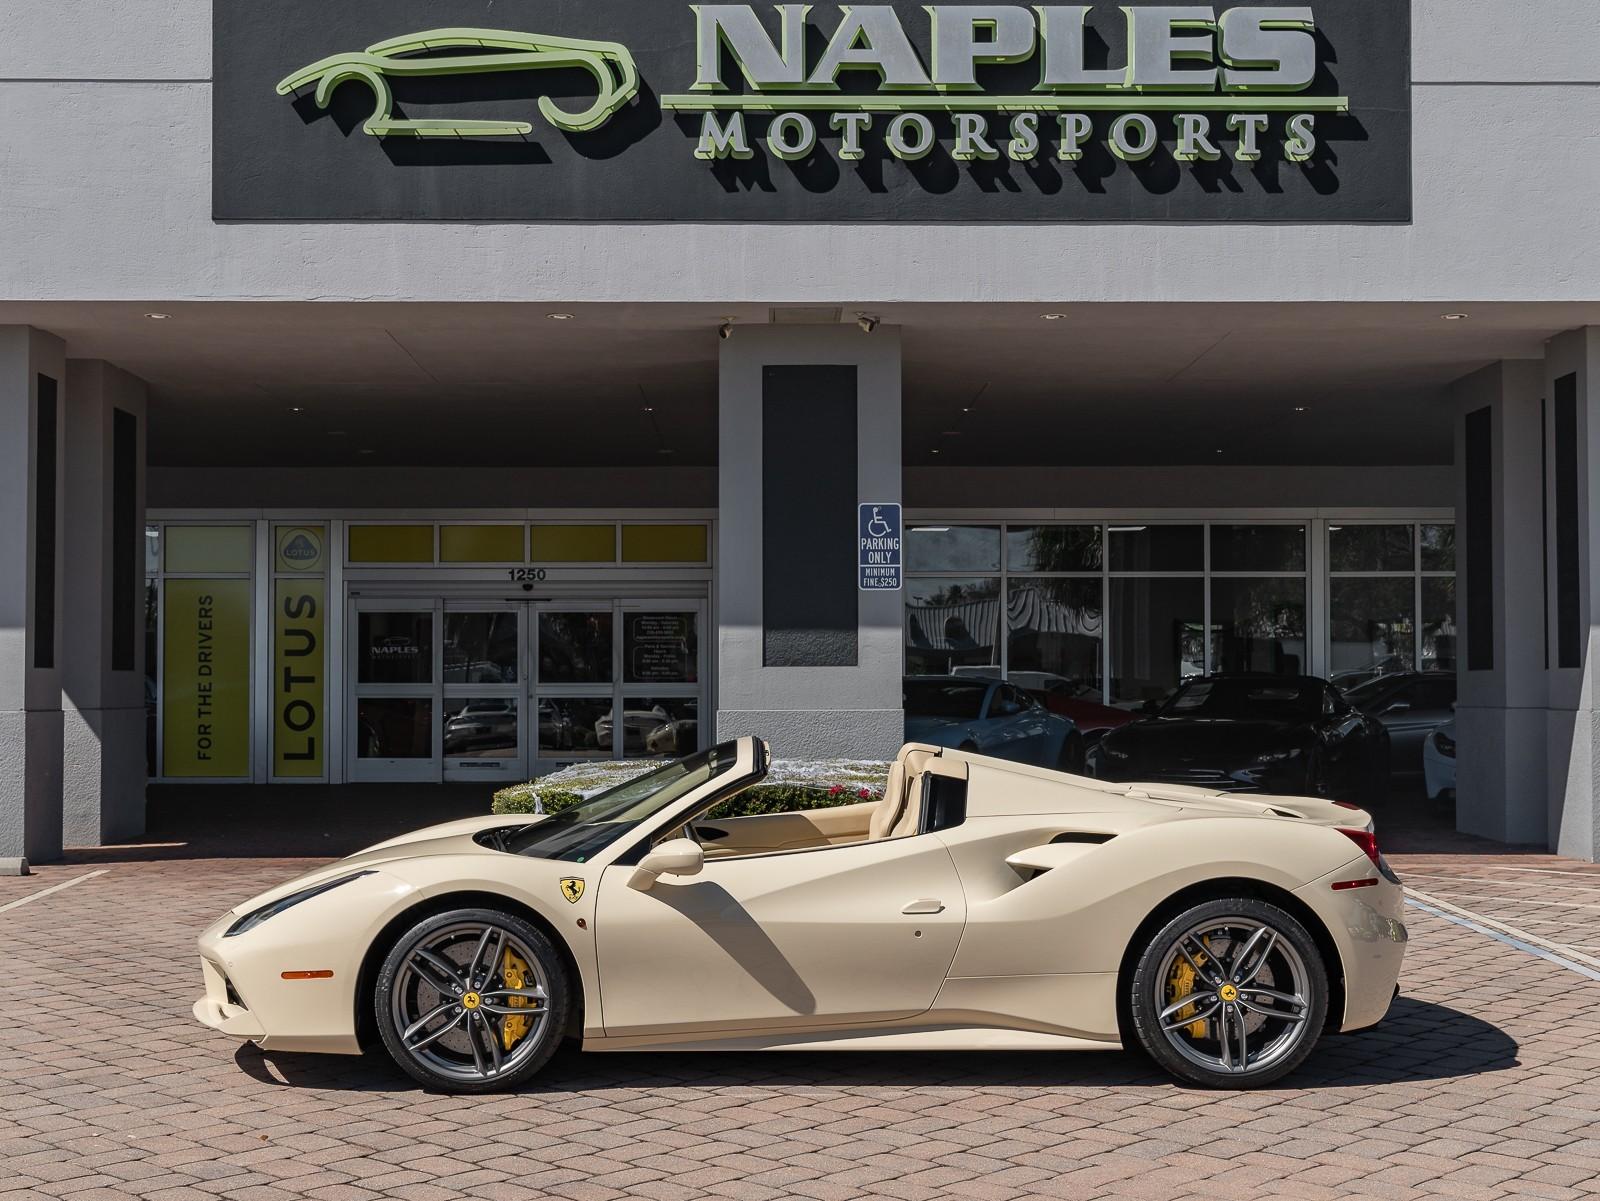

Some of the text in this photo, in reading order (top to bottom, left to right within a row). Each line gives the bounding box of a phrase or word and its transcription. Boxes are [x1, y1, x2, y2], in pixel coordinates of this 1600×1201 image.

[689, 4, 1317, 91] NAPLES
[694, 111, 1317, 162] MOTORSPORTS
[861, 537, 899, 550] PARKING
[869, 552, 892, 563] ONLY
[508, 567, 546, 581] 1250
[866, 568, 895, 577] MINIMUM
[863, 577, 897, 587] FINE $250
[370, 646, 420, 654] NAPLES
[197, 595, 214, 760] FOR THE DRIVERS
[284, 595, 316, 760] LOTUS
